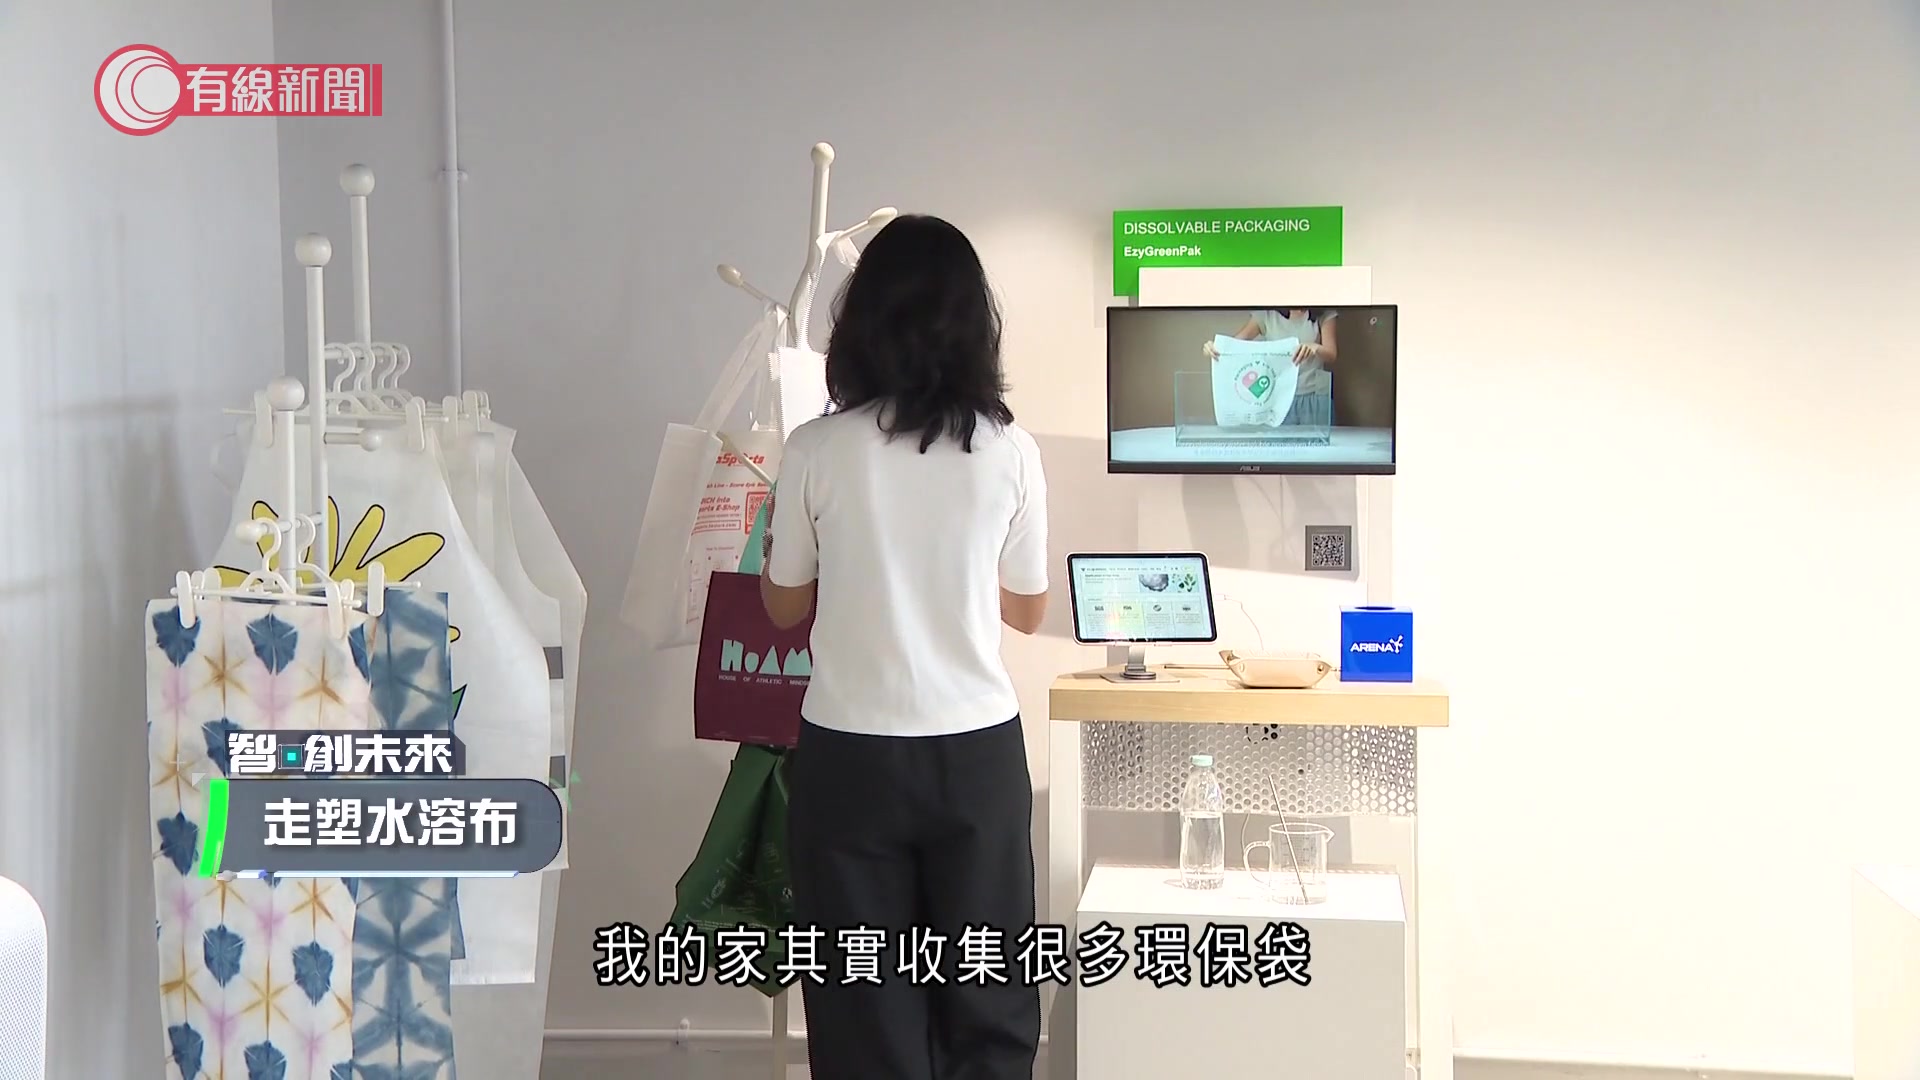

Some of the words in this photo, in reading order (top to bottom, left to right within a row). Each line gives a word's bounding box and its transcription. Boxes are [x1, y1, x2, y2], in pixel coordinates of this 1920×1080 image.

[1123, 221, 1221, 235] DISSOLVABLE
[1224, 219, 1311, 233] PACKAGING
[1123, 246, 1202, 260] EzyGreenPak
[718, 674, 736, 682] HOUSE
[756, 677, 782, 685] ATHLETIC
